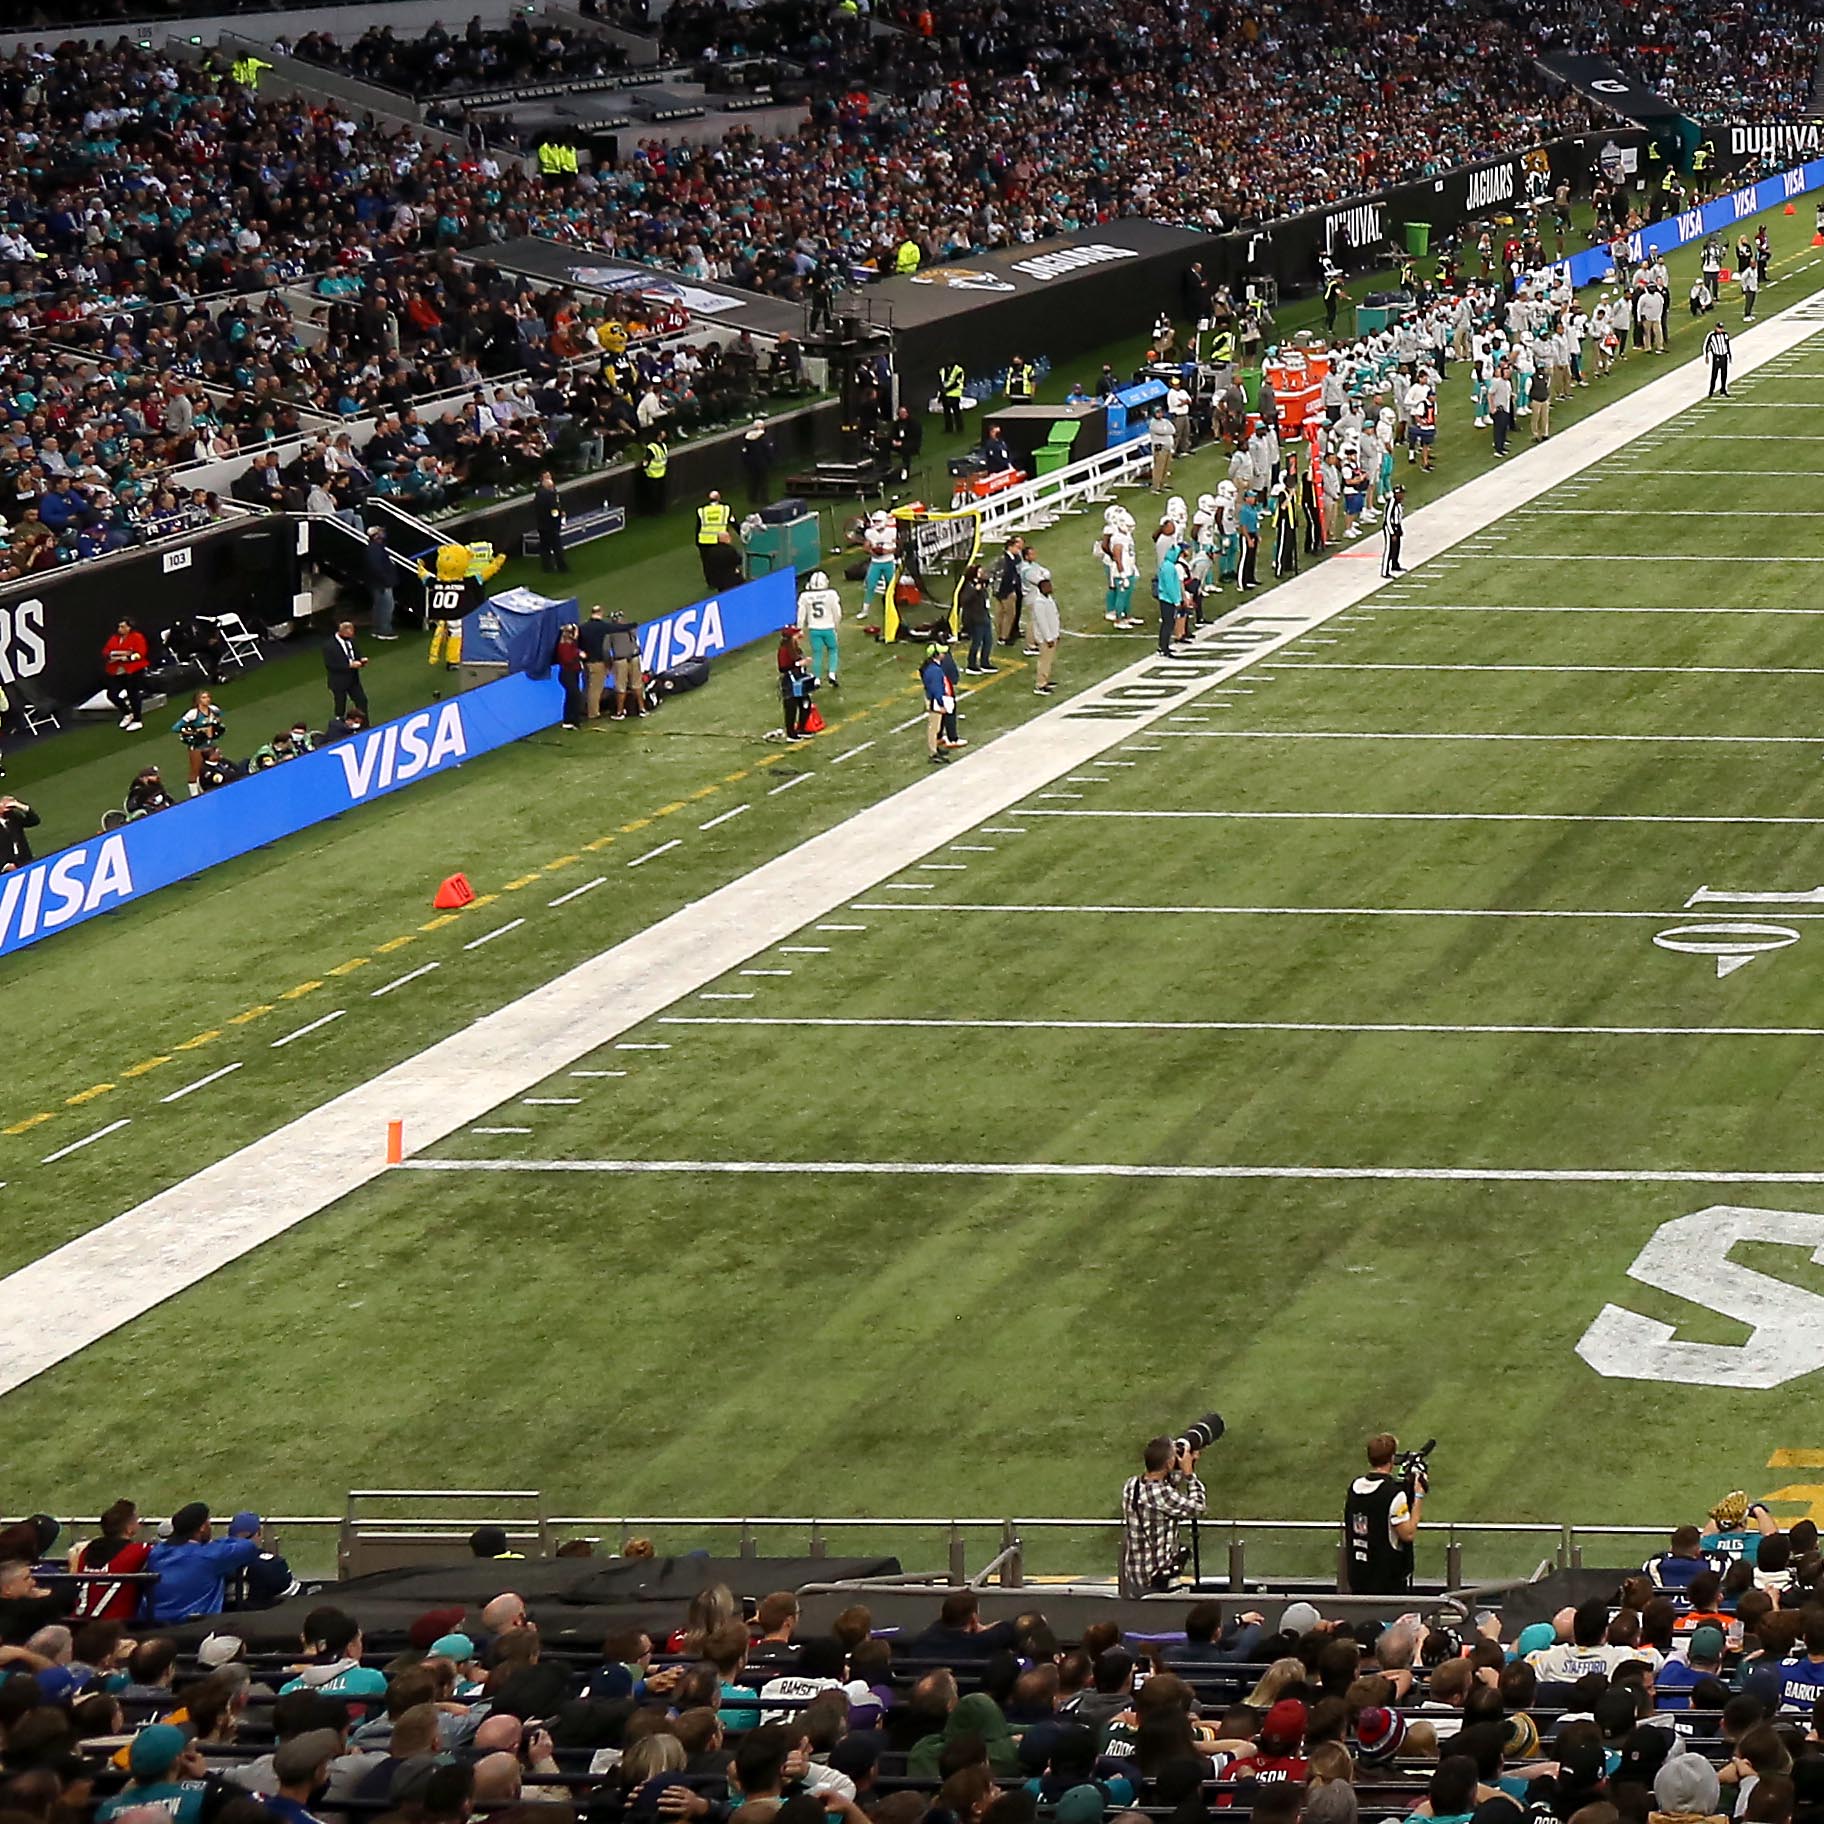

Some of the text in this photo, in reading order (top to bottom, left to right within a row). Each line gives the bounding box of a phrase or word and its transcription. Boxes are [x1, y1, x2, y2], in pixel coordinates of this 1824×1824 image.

[1466, 165, 1514, 211] JAGUARS
[1784, 165, 1806, 198] VISA
[1732, 186, 1757, 218] VISA
[1676, 209, 1702, 243] VISA
[1011, 243, 1138, 282] JAGUARS
[169, 553, 187, 566] 103
[434, 592, 459, 609] 00
[812, 601, 824, 619] 5
[328, 702, 467, 800] VISA
[452, 877, 469, 896] 10
[1562, 1659, 1608, 1676] STAFFORD
